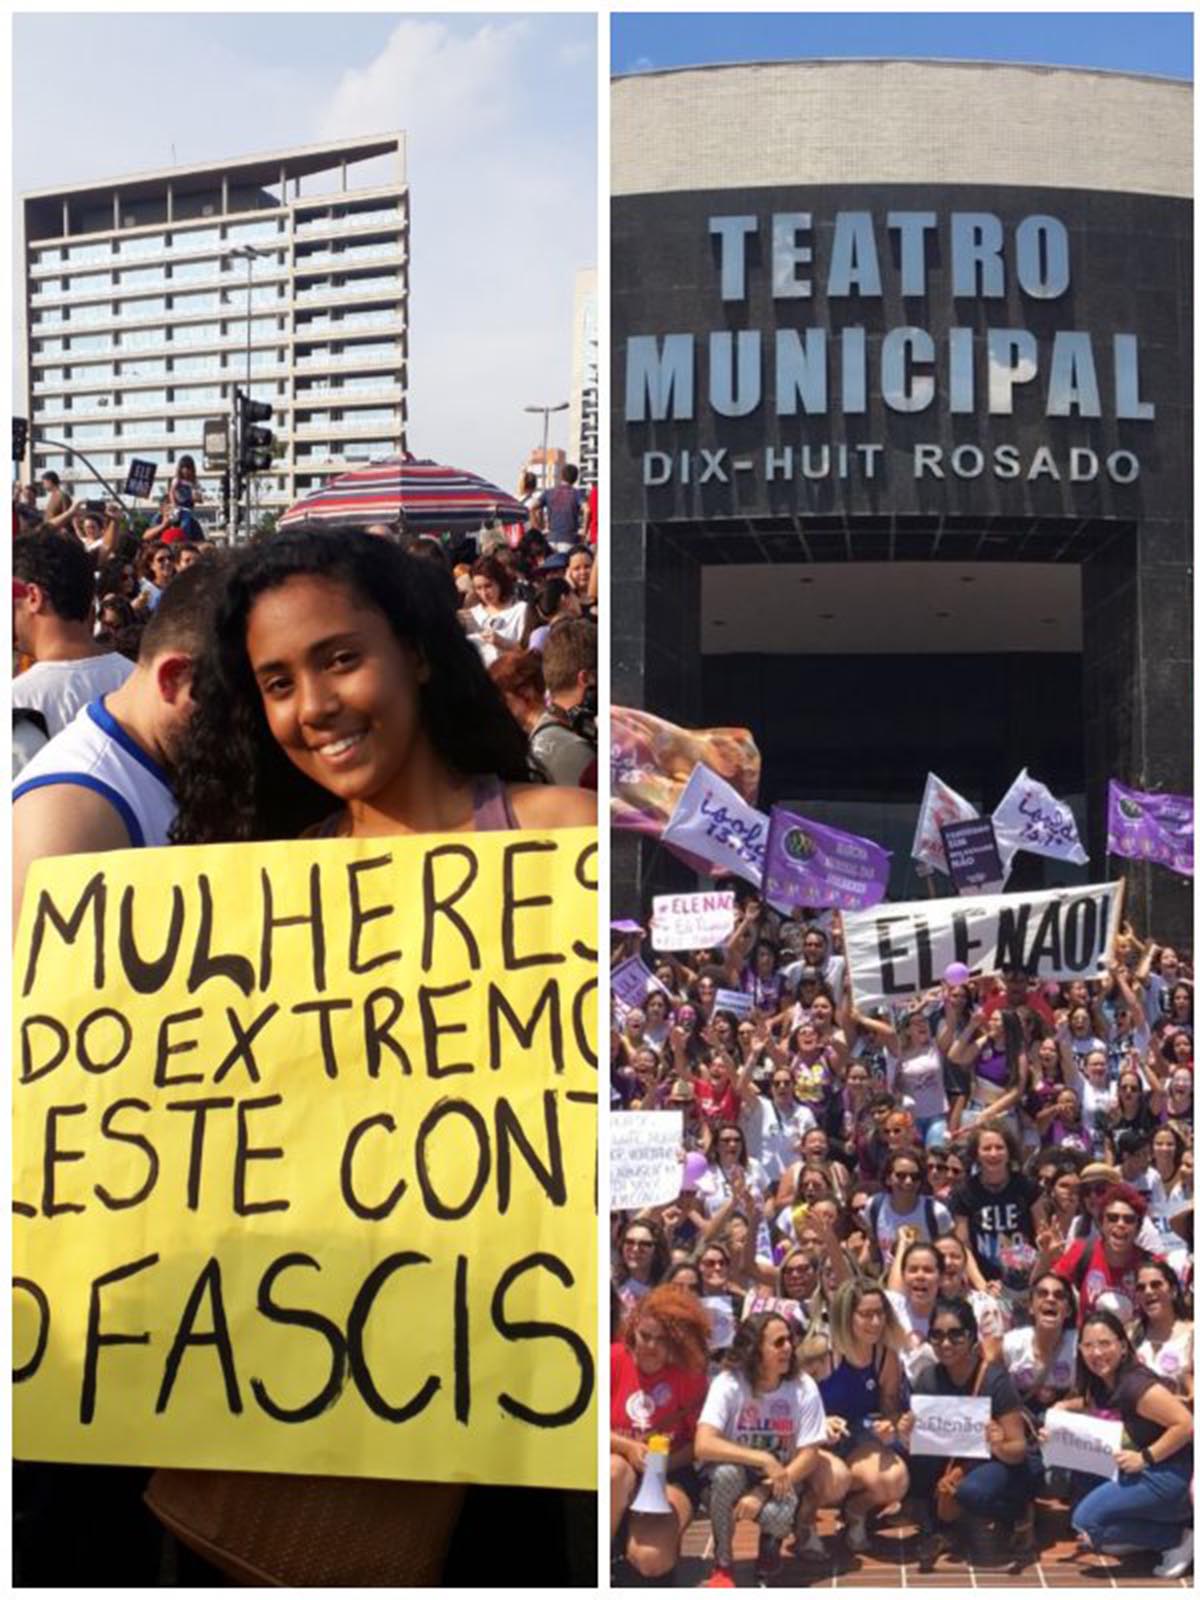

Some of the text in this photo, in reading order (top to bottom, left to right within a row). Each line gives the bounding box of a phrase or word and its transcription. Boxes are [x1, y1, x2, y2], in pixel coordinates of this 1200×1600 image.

[709, 211, 1072, 301] TEATRO
[624, 325, 1156, 422] MUNICIPAL
[642, 443, 1141, 487] DIX-HUIT ROSADO
[875, 891, 1110, 994] ELE NÃO!
[19, 1007, 133, 1085] DO
[981, 1203, 1018, 1230] ELE
[79, 1250, 595, 1428] FASCIS
